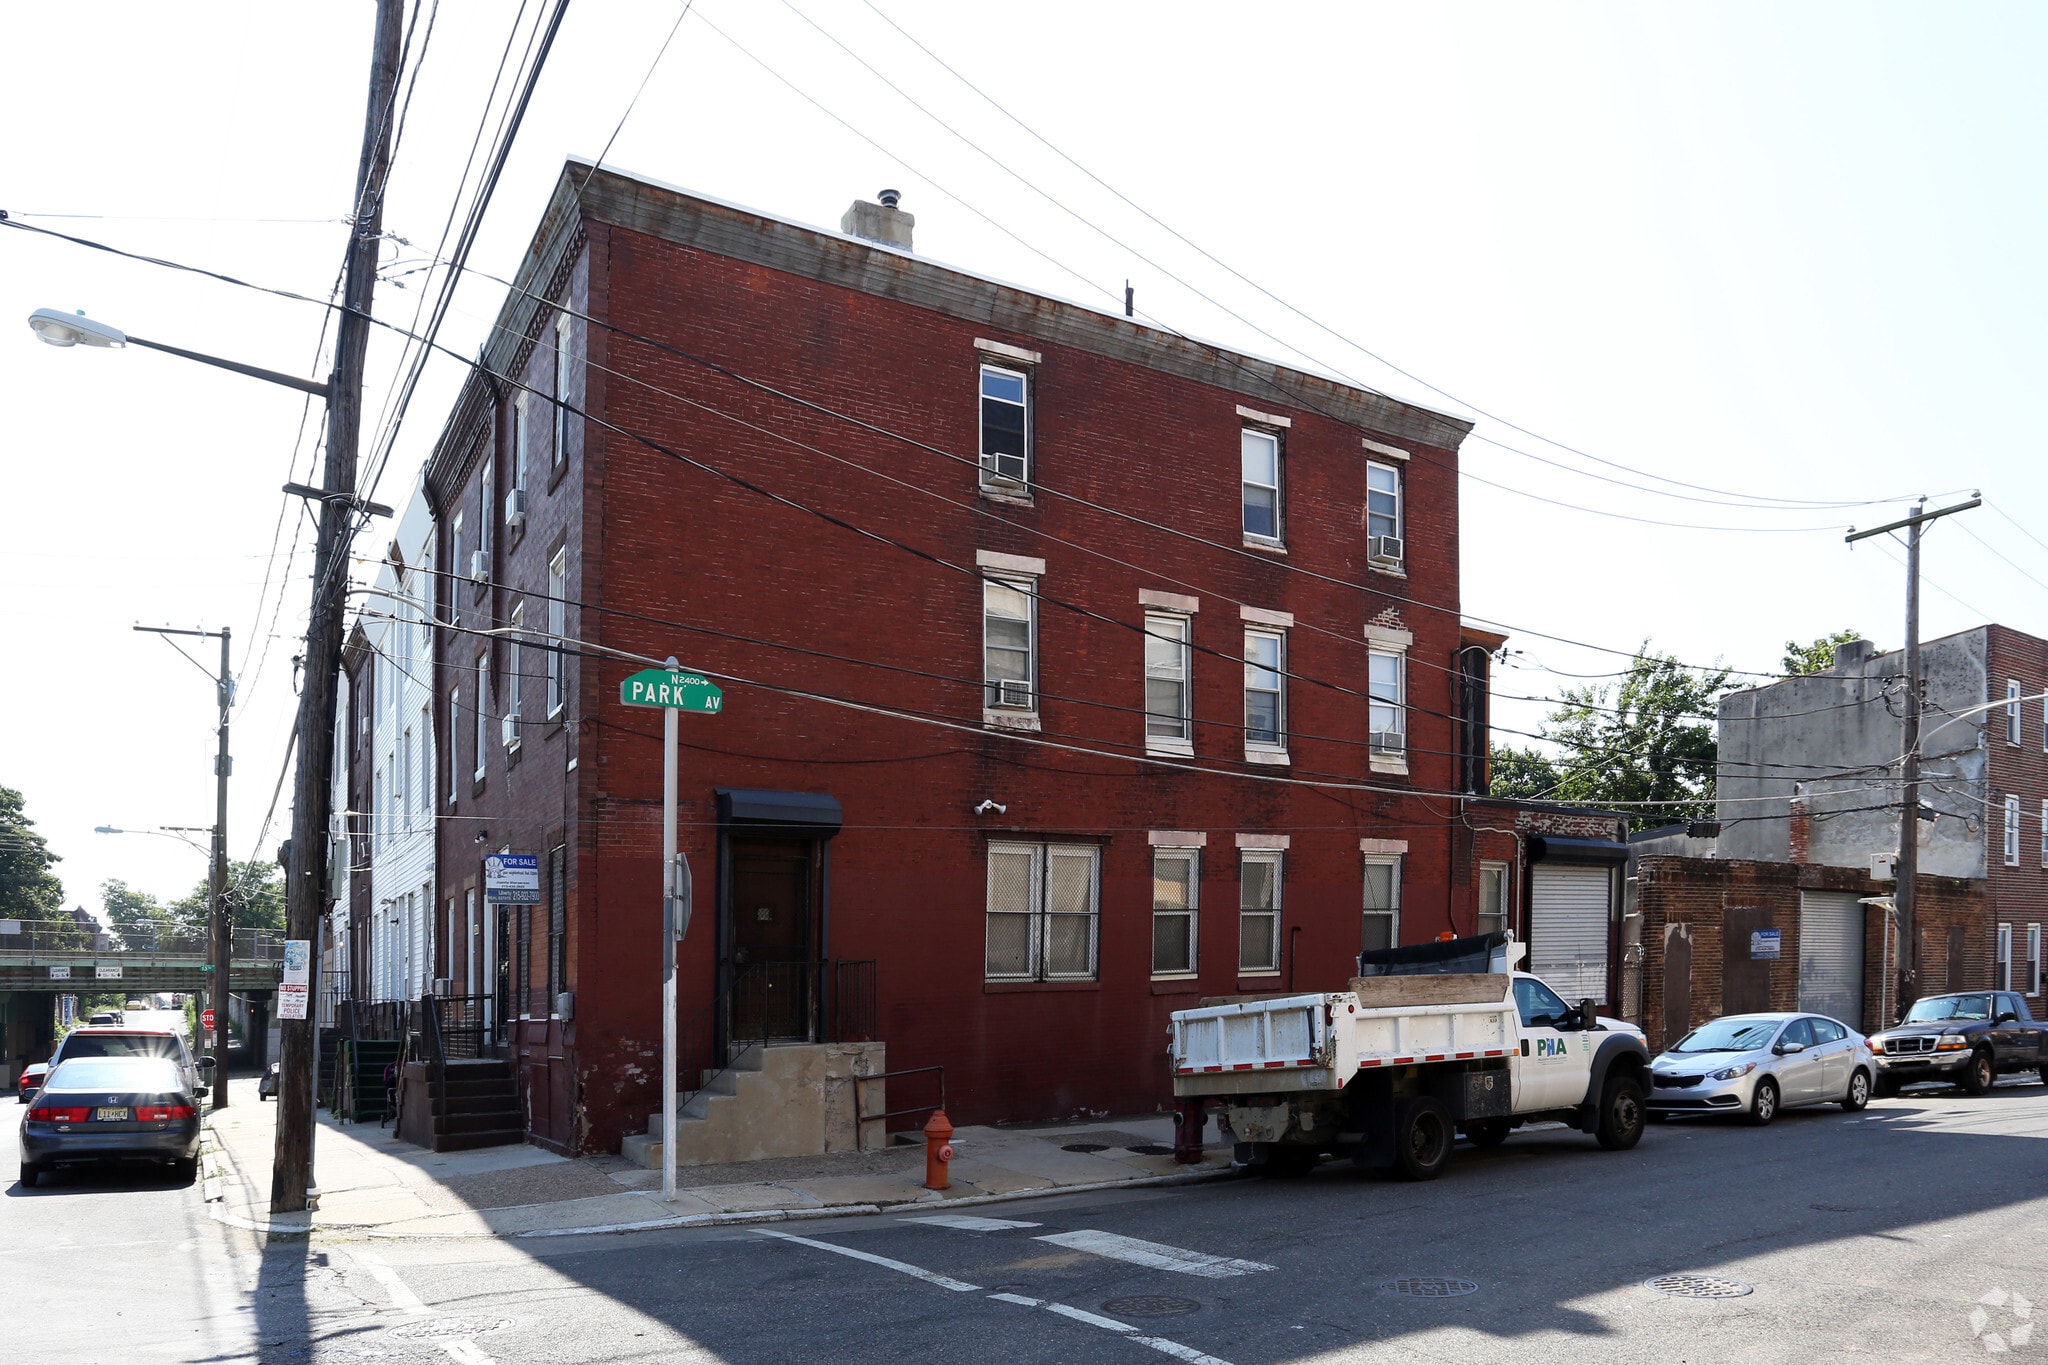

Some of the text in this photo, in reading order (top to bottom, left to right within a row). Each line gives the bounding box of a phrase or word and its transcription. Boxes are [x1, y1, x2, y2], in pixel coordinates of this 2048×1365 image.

[632, 682, 720, 709] PARK AV
[1537, 1038, 1567, 1057] PHA
